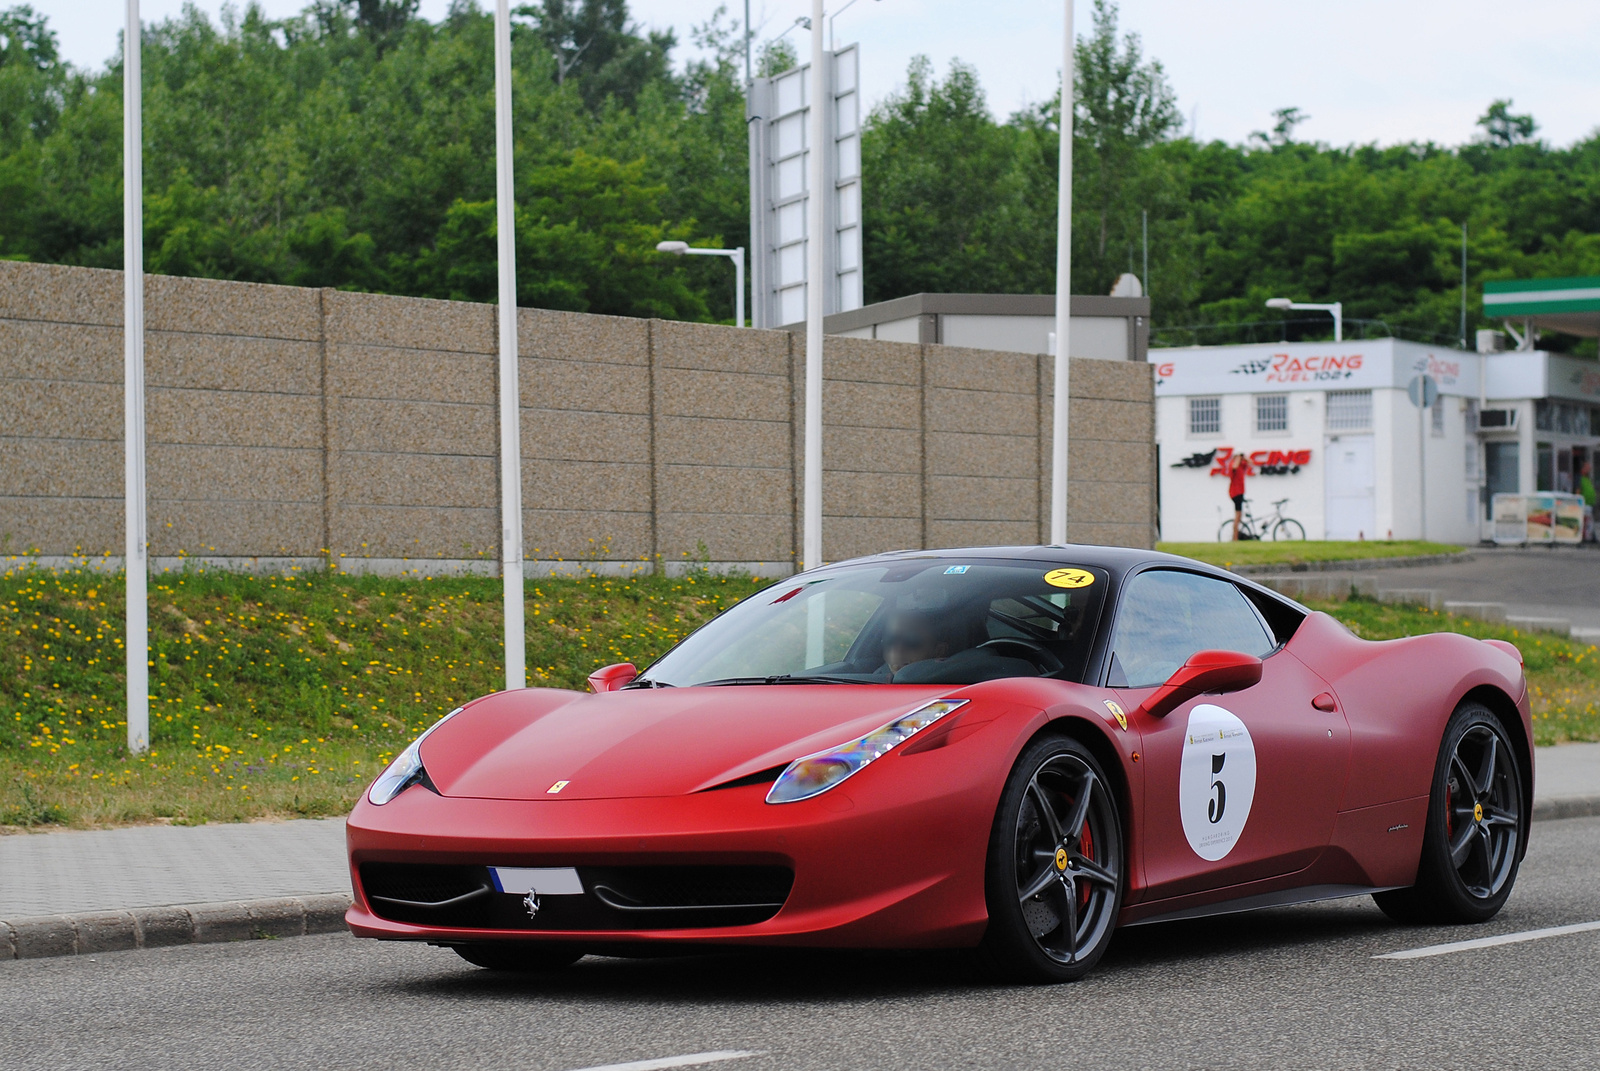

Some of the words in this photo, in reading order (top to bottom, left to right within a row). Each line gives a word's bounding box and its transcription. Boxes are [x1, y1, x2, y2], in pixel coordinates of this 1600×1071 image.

[1272, 353, 1363, 372] RACING
[1266, 372, 1310, 382] FUEL
[1314, 370, 1353, 381] 102+
[1215, 447, 1312, 466] RCING
[1050, 570, 1086, 583] 74
[1208, 752, 1226, 824] 5
